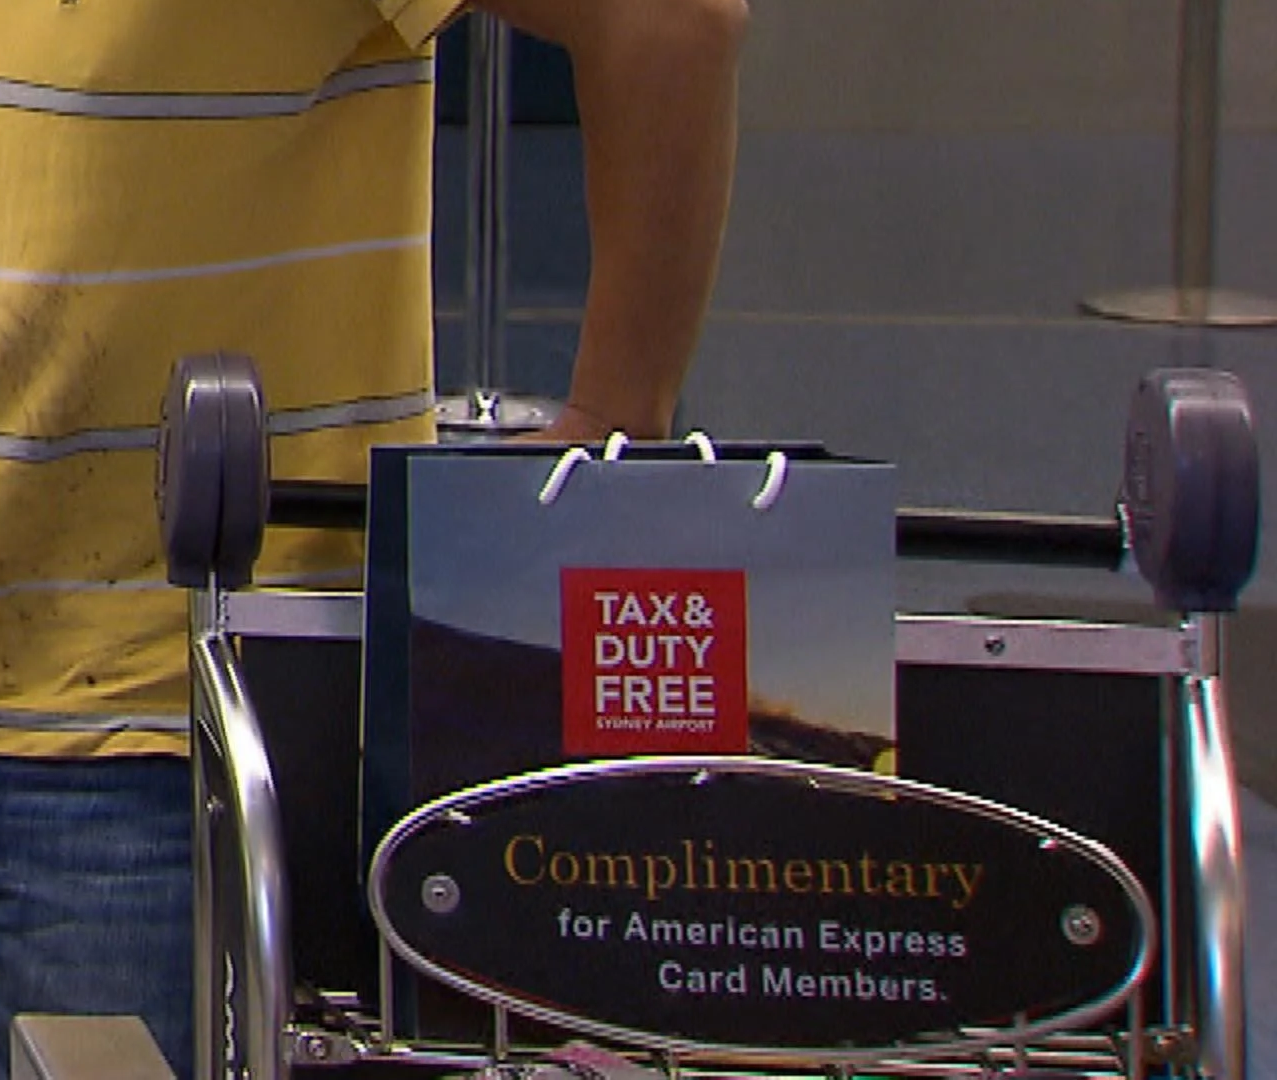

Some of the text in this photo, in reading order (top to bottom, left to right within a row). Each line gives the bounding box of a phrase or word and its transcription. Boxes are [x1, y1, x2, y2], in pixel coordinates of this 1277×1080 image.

[595, 634, 715, 669] DUTY
[595, 674, 716, 715] FREE
[596, 716, 716, 733] SYDNEY AIRPORT
[503, 833, 985, 910] Complimentary
[557, 907, 968, 959] for American Express
[657, 959, 949, 1003] Card Members.
